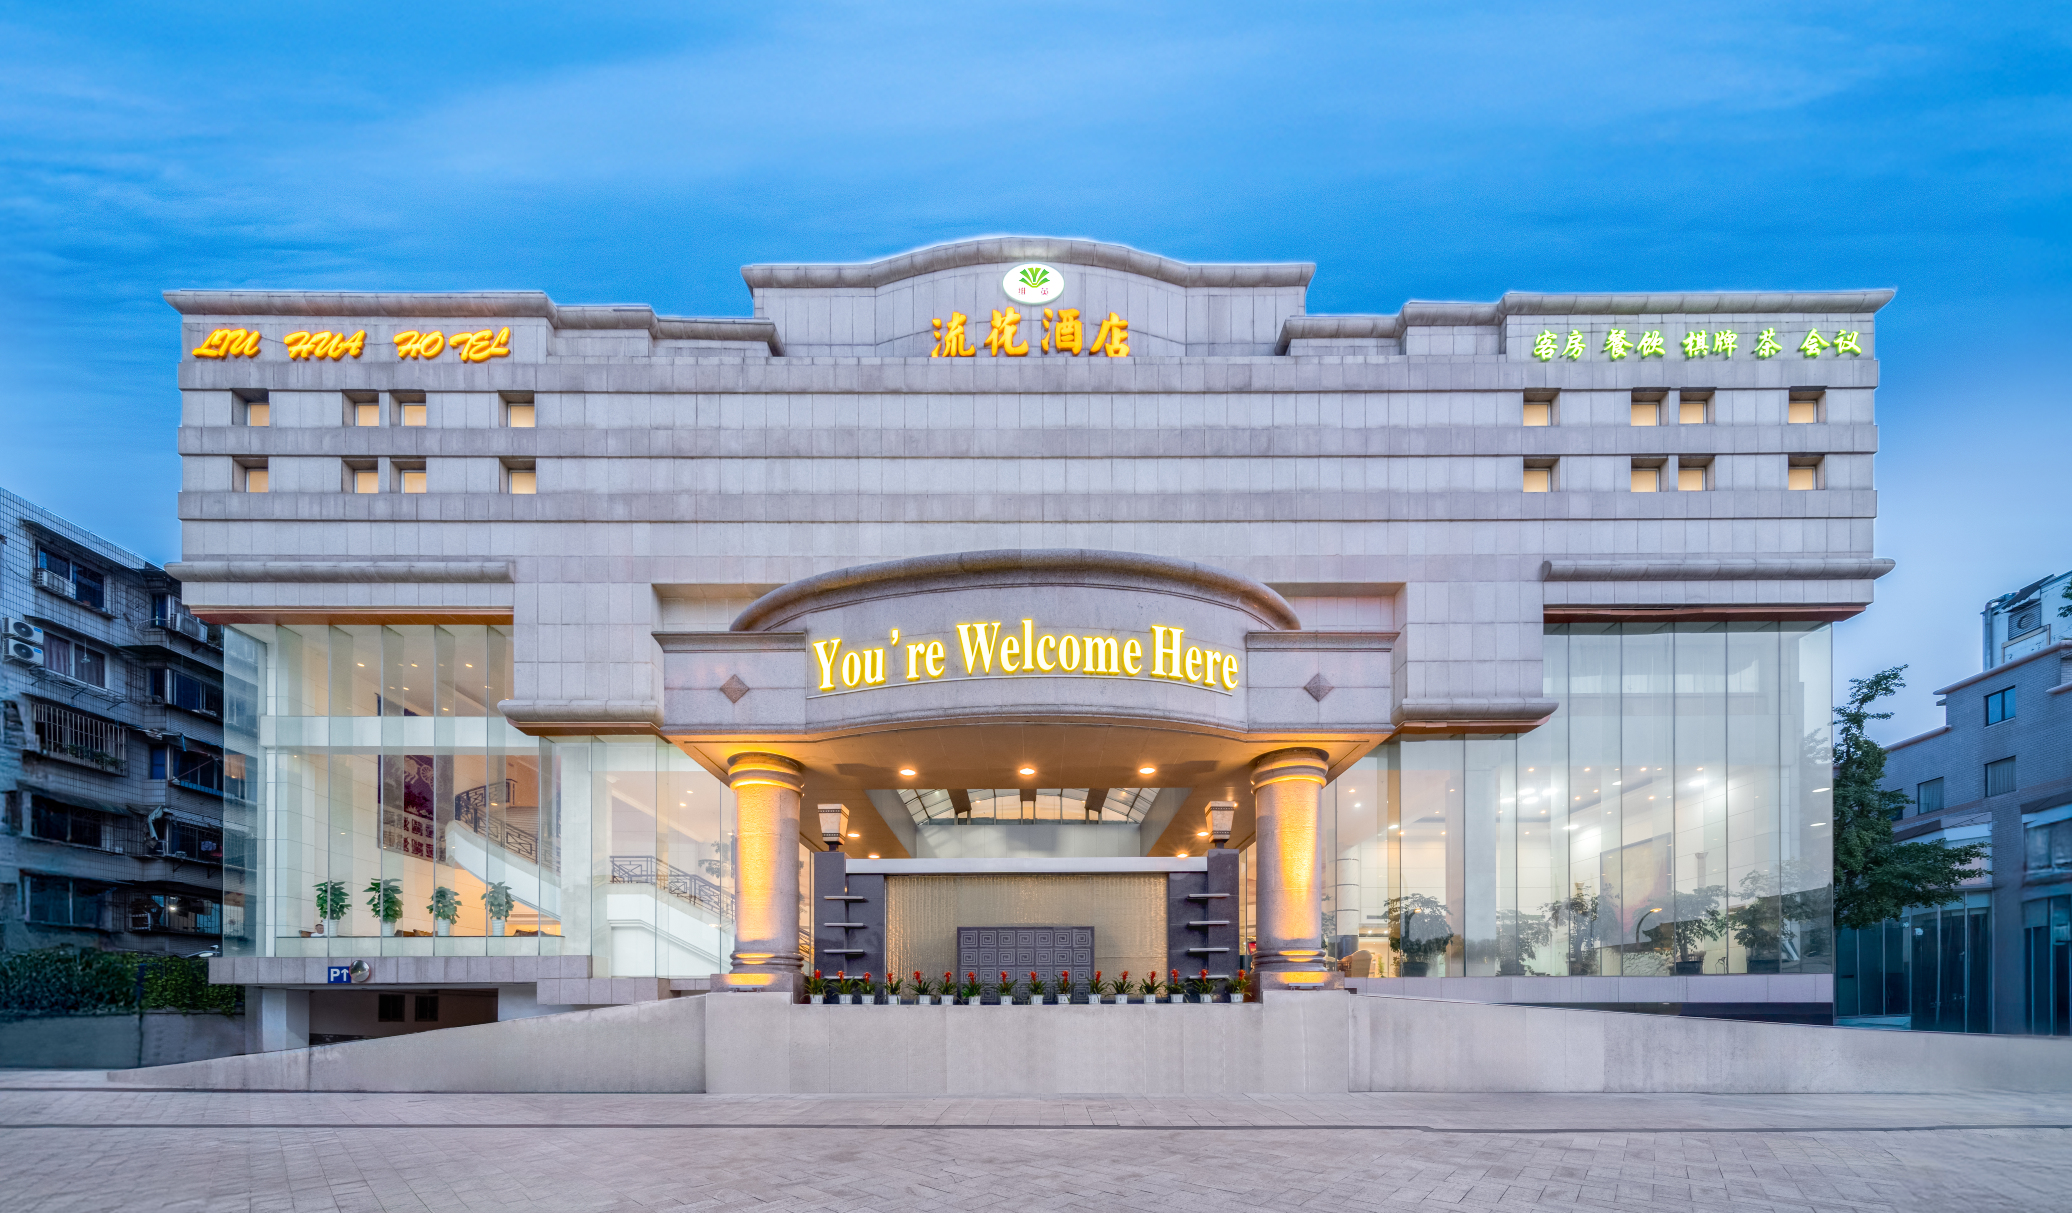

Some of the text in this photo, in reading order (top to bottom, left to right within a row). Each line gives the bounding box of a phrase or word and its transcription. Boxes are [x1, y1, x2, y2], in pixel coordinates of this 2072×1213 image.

[192, 328, 262, 358] LIU
[283, 329, 367, 361] HUA
[931, 306, 1130, 357] 流花酒店
[1533, 328, 1862, 360] 客房 餐饮 棋牌 茶 会议
[956, 619, 1143, 675] Welcome
[1150, 624, 1240, 689] Here
[330, 968, 340, 982] P
